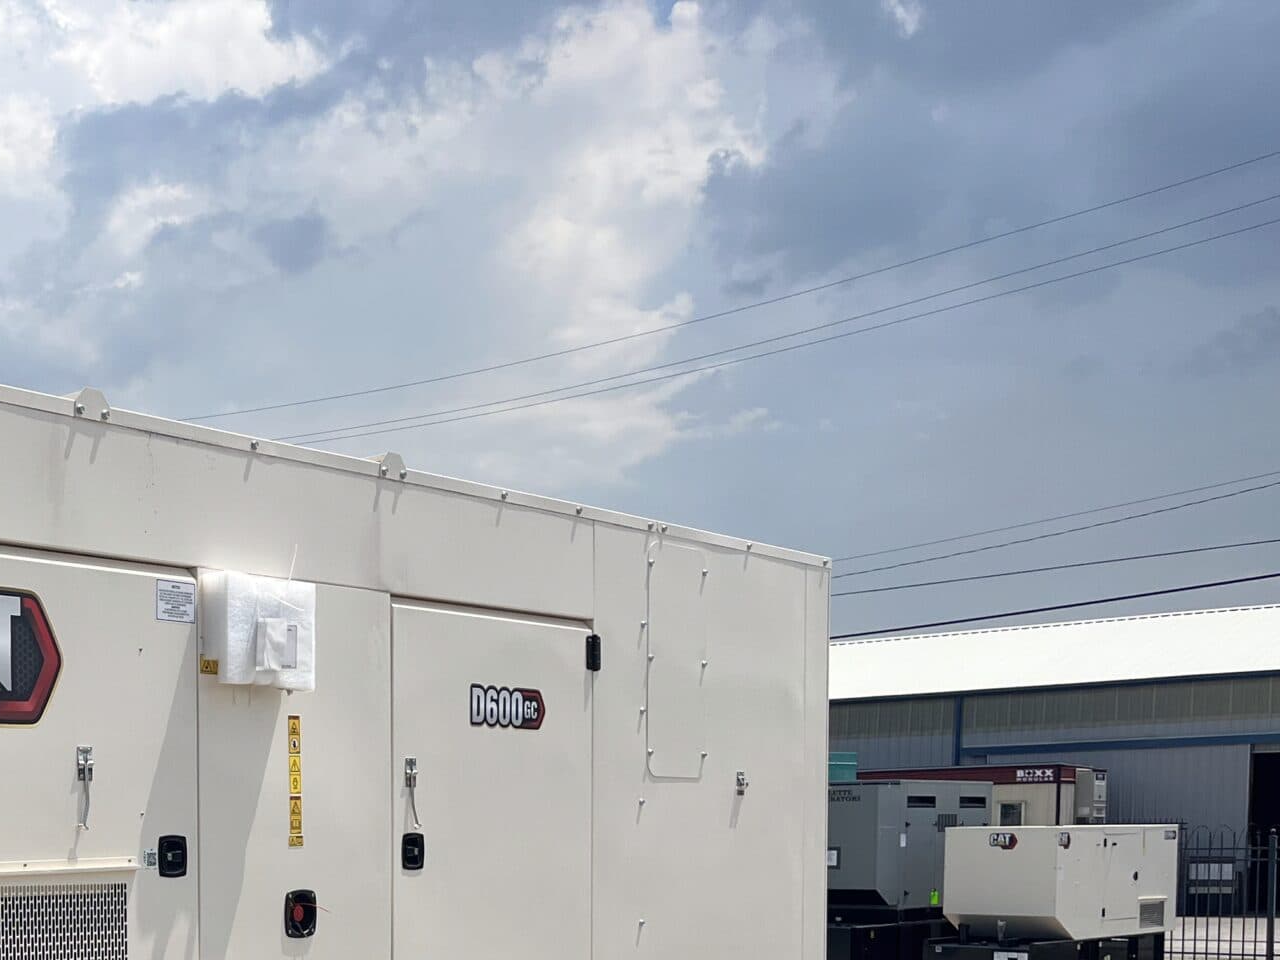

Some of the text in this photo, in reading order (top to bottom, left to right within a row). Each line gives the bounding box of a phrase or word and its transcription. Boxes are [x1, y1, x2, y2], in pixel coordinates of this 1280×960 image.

[471, 685, 538, 727] D600 GC
[991, 833, 1012, 846] CAT
